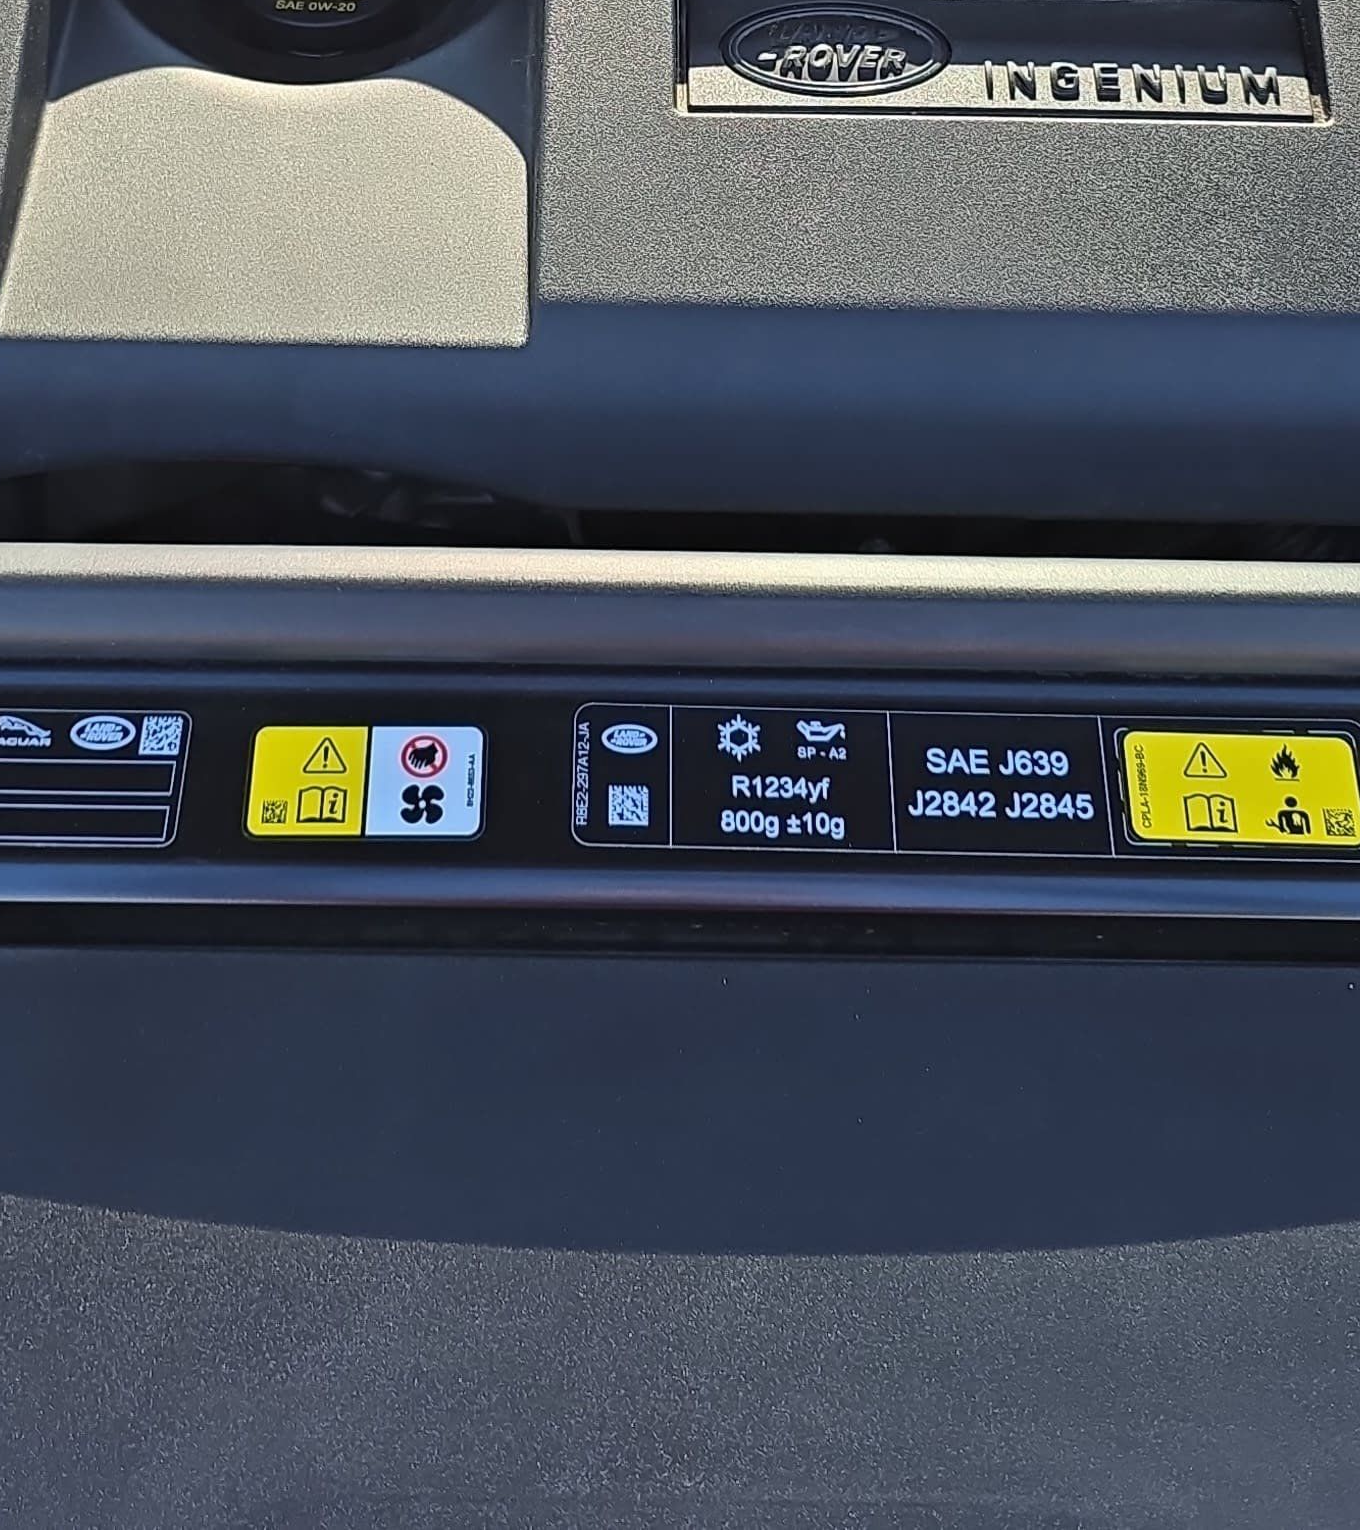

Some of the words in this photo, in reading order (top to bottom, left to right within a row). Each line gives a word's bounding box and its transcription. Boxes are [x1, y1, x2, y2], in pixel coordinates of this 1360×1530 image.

[275, 0, 304, 11] SAE
[308, 2, 356, 12] 0W-20
[984, 60, 1281, 106] INGENIUM
[797, 746, 817, 760] SP
[828, 747, 848, 761] A2
[926, 747, 990, 775] SAE
[998, 749, 1070, 777] J639
[731, 774, 832, 804] R1234yf
[907, 789, 997, 819] J2842
[1004, 791, 1096, 821] J2845
[720, 809, 781, 839] 800g
[785, 811, 846, 840] ±10g
